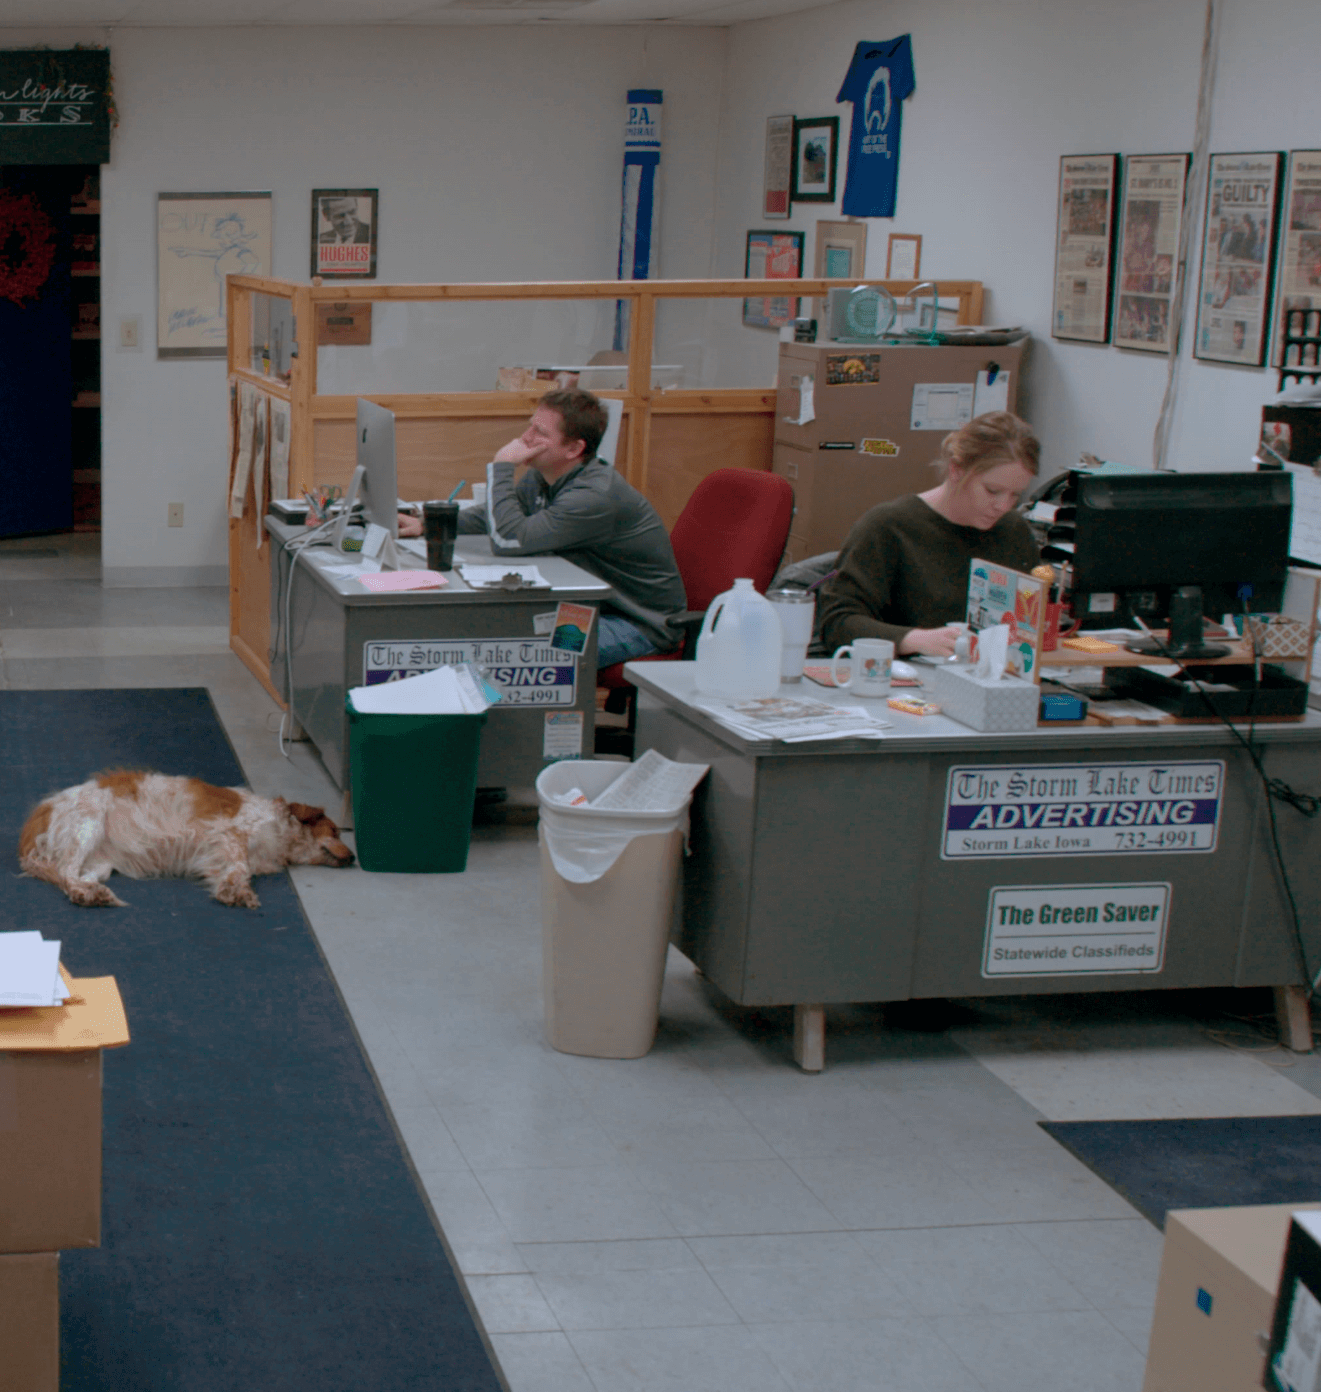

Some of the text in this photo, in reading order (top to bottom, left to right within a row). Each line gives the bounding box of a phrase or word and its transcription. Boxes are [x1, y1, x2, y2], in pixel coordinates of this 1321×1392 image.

[21, 78, 96, 113] lights
[1223, 184, 1270, 202] GUILTY
[320, 246, 369, 262] HUGHES
[372, 643, 572, 669] The Storm Lake Times
[957, 768, 1217, 802] The Storm Lake Times
[969, 801, 1196, 830] ADVERTISING
[962, 830, 1198, 851] Storm Lake Iowa 732-4991
[998, 901, 1160, 926] The Green Saver
[993, 943, 1155, 960] Statewide Classifieds
